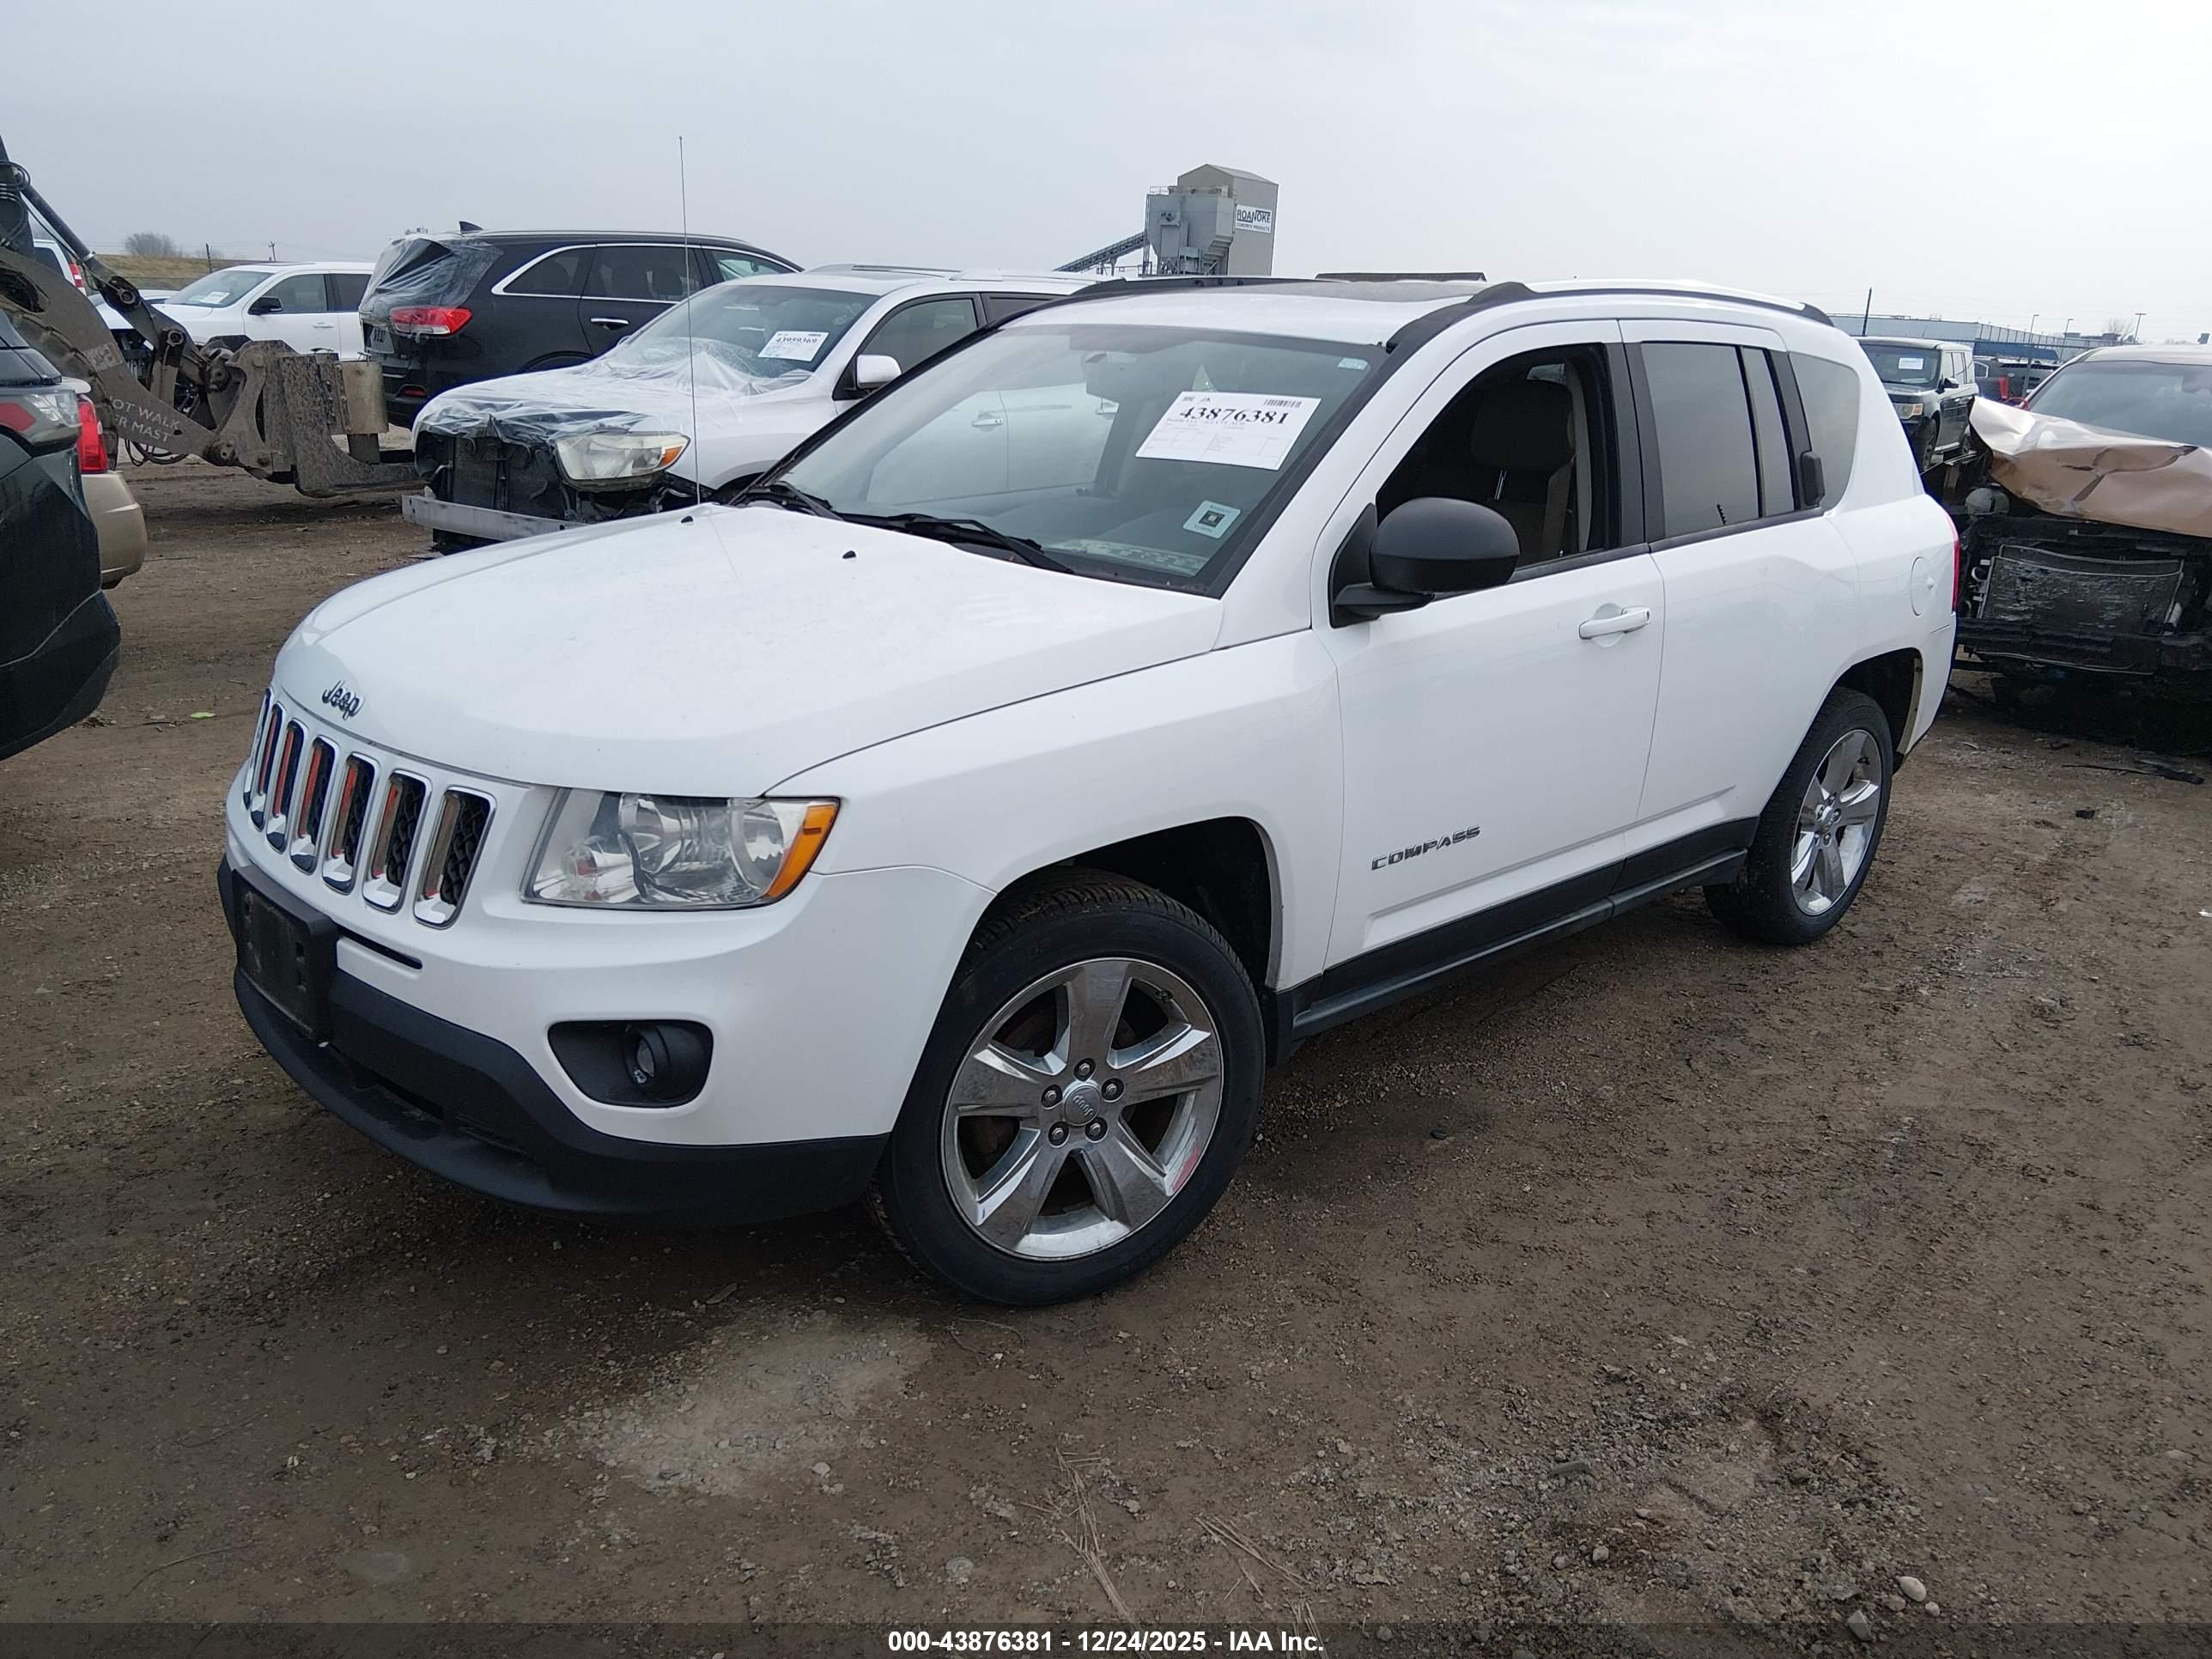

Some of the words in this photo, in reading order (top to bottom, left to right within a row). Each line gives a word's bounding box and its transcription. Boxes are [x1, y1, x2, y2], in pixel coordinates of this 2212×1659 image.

[1237, 209, 1271, 223] ROANOKE
[109, 396, 136, 412] OT
[138, 406, 179, 429] WALK
[1179, 406, 1289, 425] 43876381
[131, 421, 173, 442] MAST
[322, 680, 361, 720] Jeep
[1371, 825, 1480, 871] COMPASS
